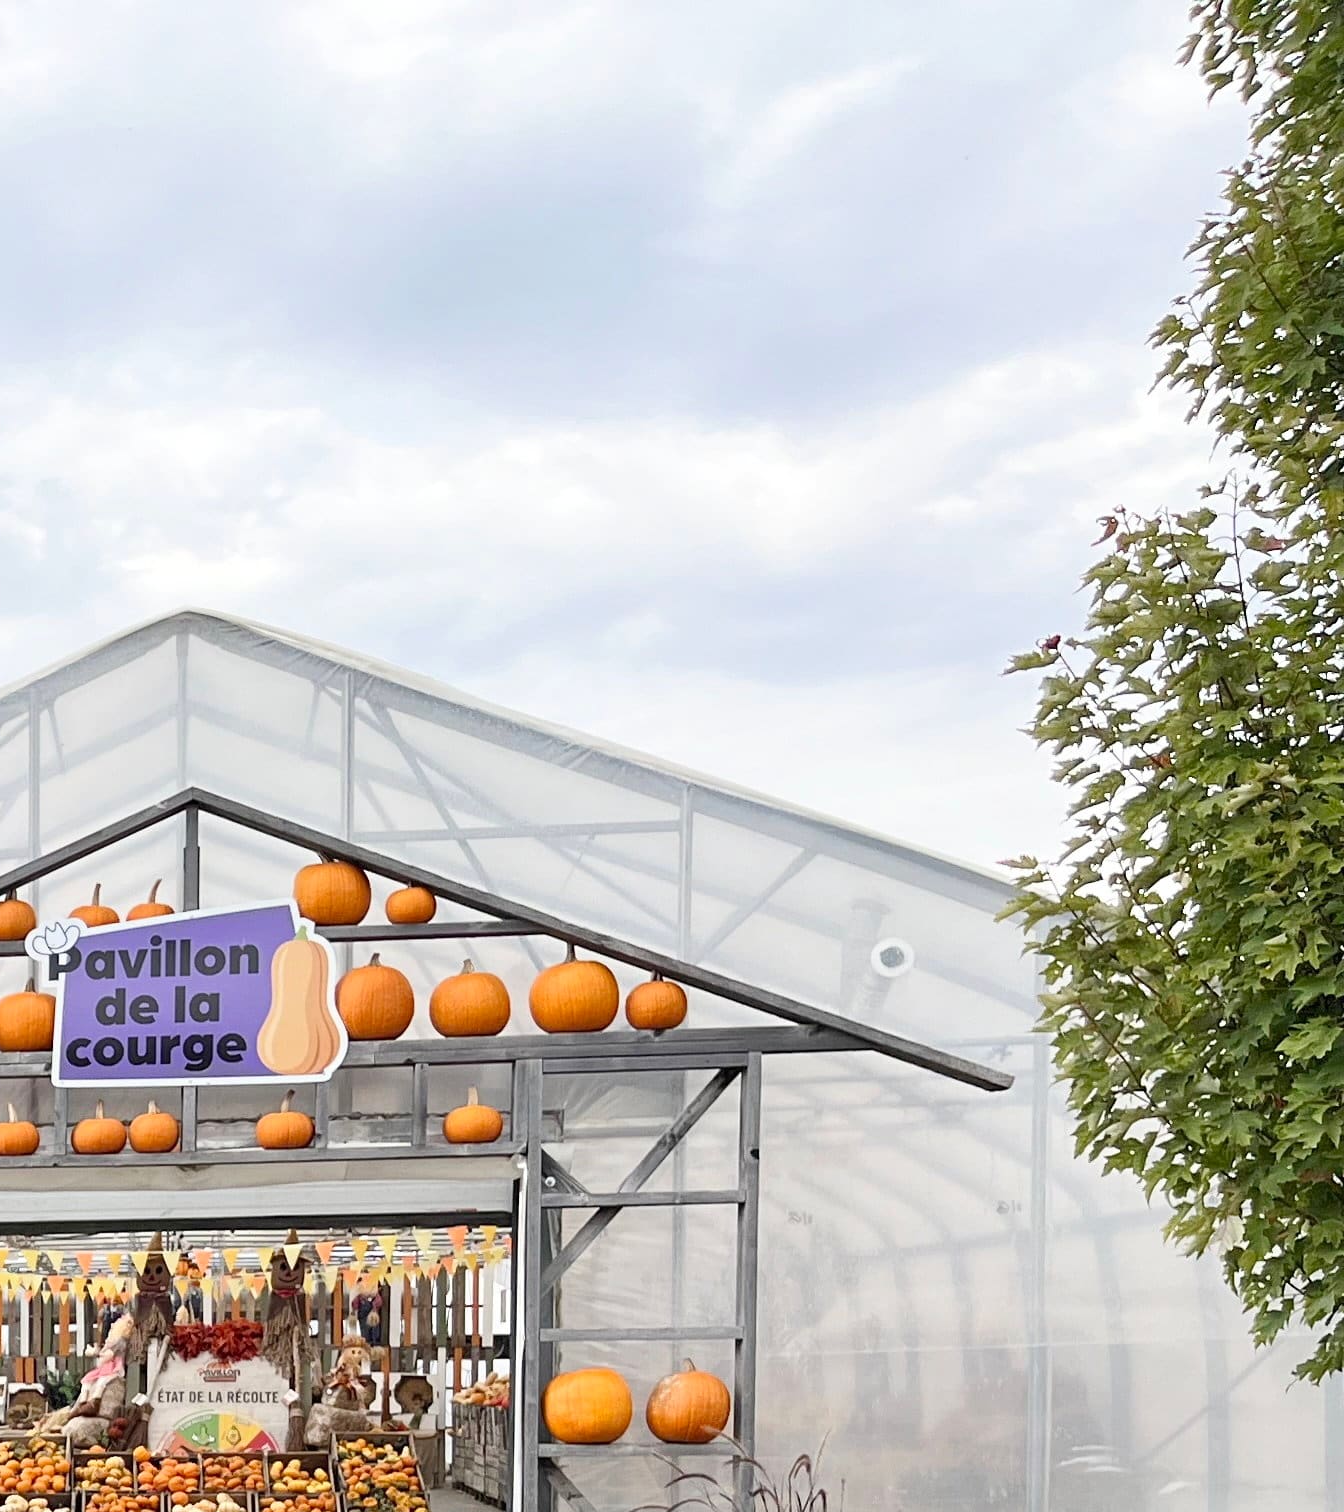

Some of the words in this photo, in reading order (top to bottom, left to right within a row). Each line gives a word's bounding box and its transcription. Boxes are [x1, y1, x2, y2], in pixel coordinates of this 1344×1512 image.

[48, 935, 260, 981] Pavillon
[95, 987, 160, 1025] de
[174, 985, 221, 1023] la
[65, 1032, 248, 1072] courge
[157, 1388, 185, 1403] ÉTAT
[189, 1391, 206, 1403] DE
[208, 1391, 223, 1403] LA
[227, 1388, 279, 1403] RÉCOLTE
